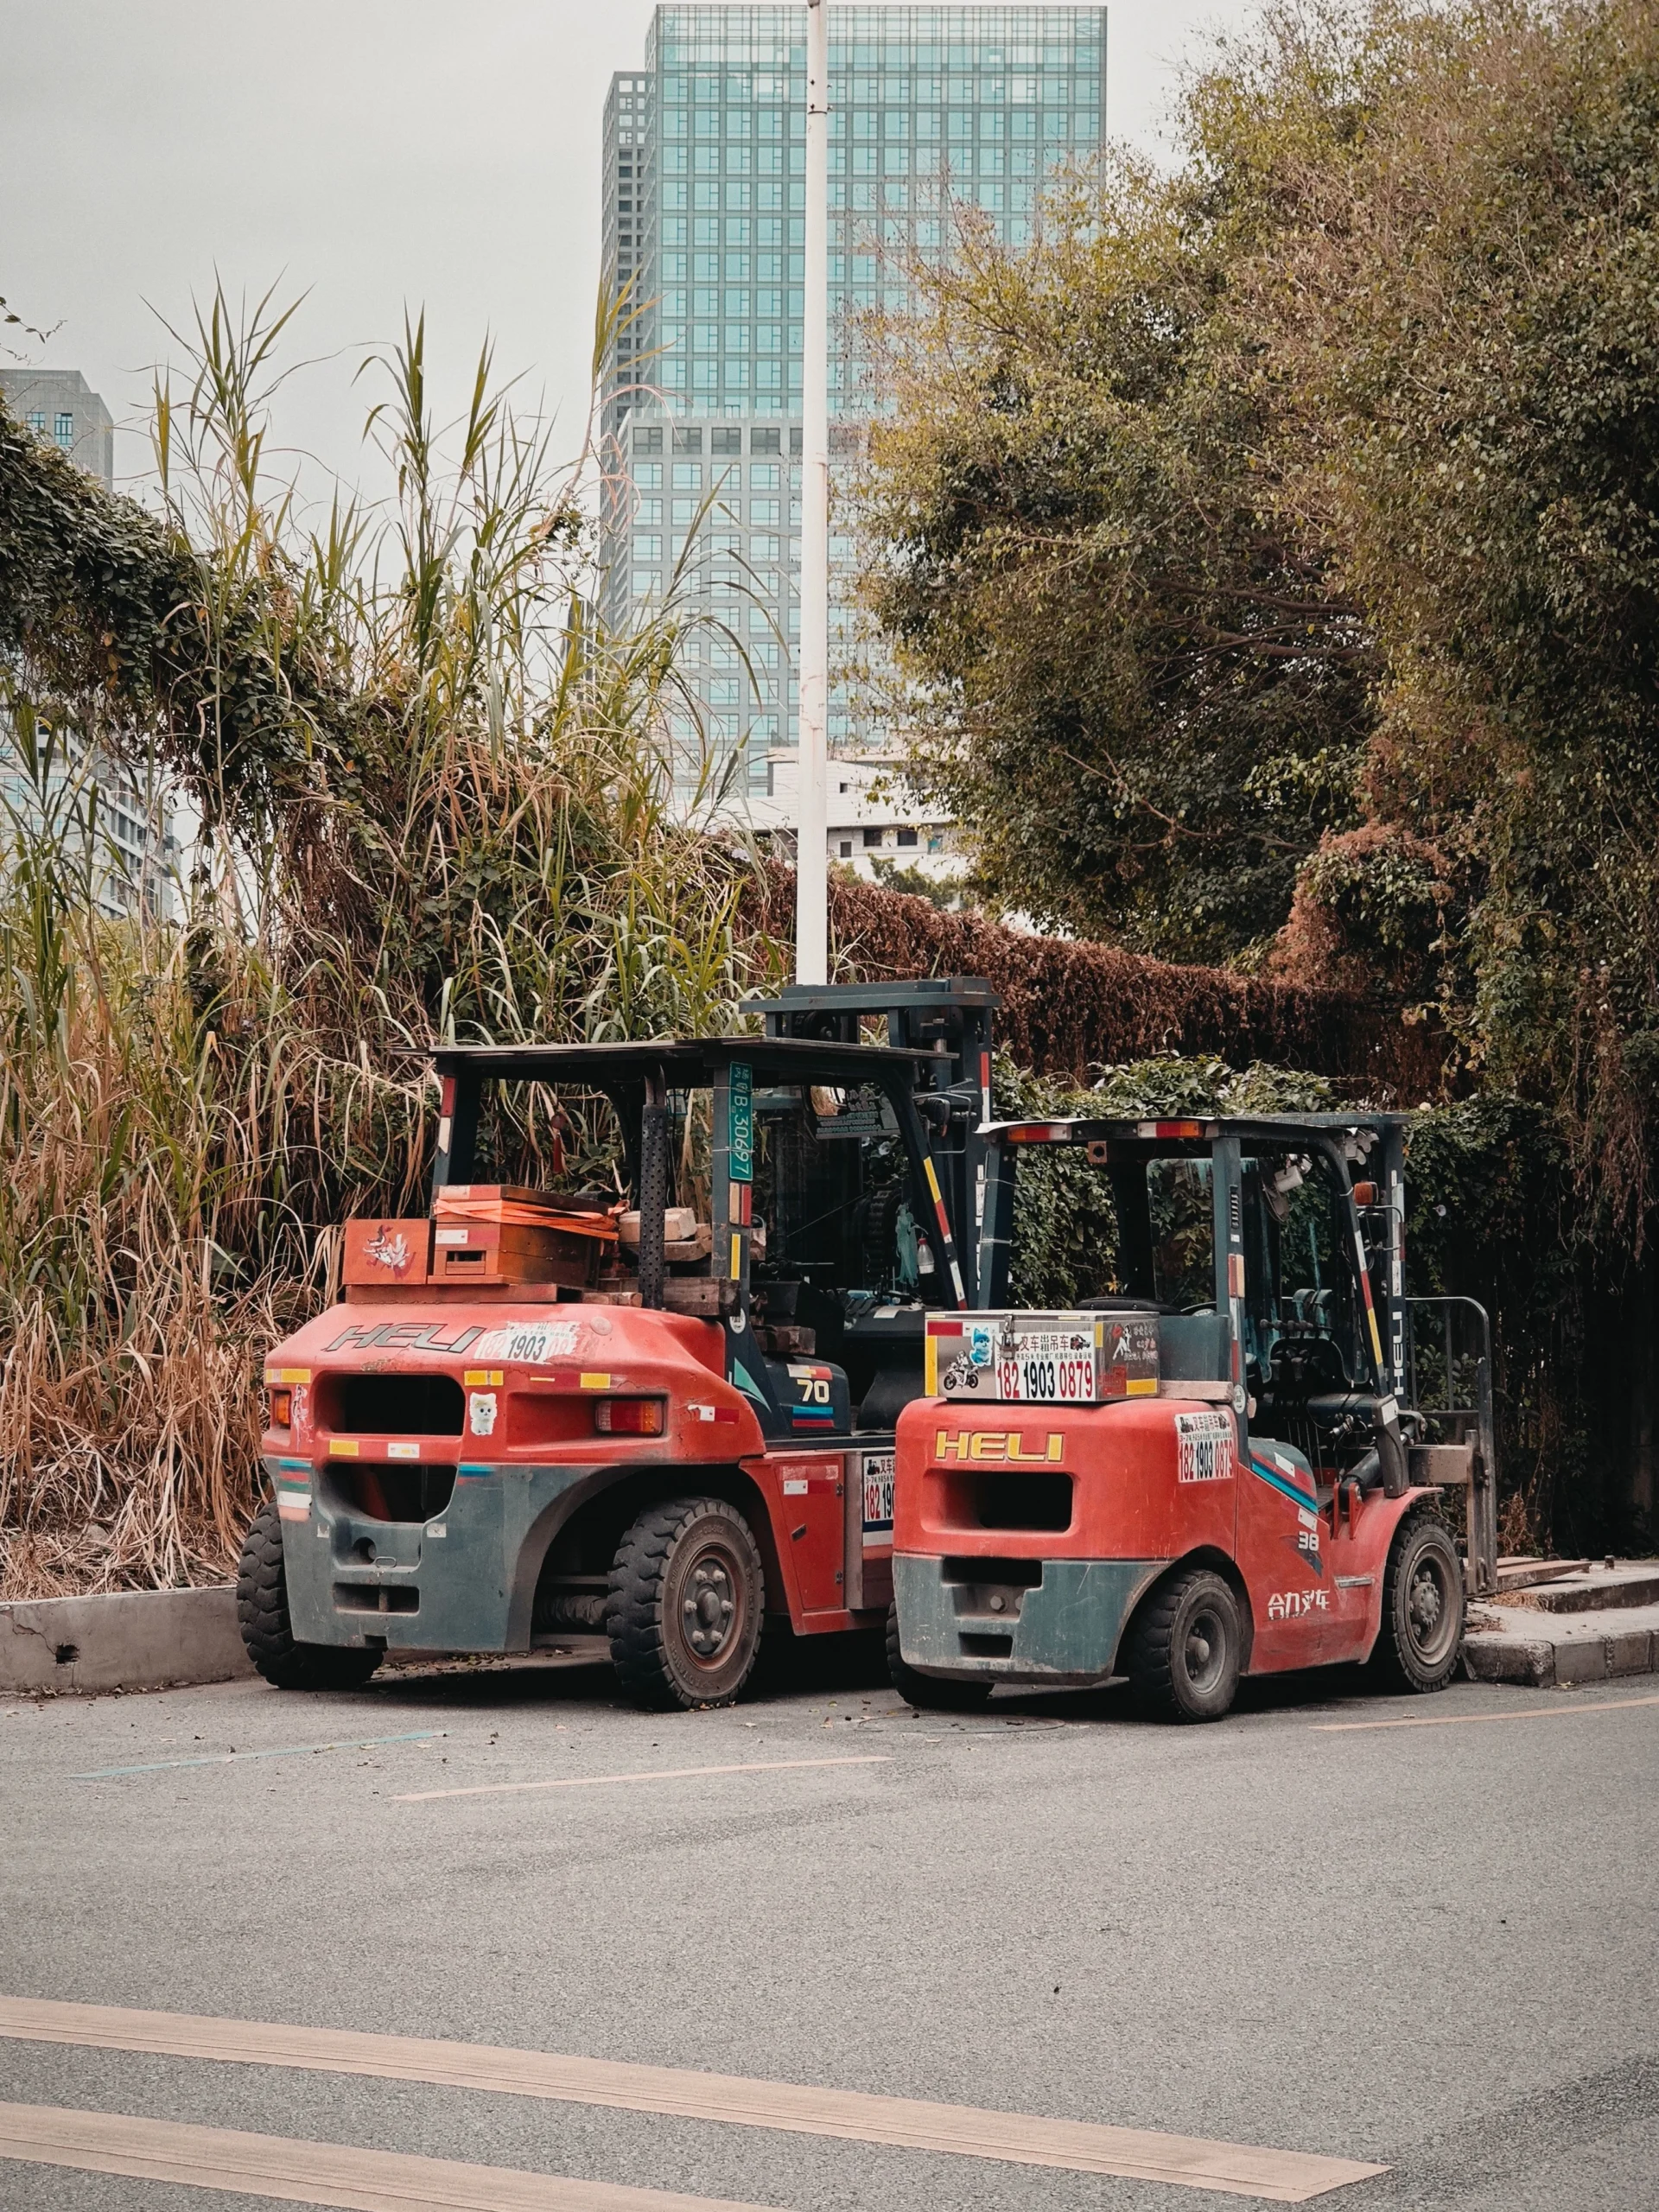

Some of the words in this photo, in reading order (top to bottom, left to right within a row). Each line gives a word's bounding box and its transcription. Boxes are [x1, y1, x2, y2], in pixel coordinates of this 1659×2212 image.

[321, 1322, 486, 1354] HELI
[507, 1334, 547, 1362] 1903
[1392, 1311, 1404, 1395] HELI
[797, 1378, 830, 1404] 70
[997, 1361, 1020, 1398] 182
[1023, 1361, 1056, 1399] 1903
[1059, 1360, 1093, 1398] 0879
[936, 1429, 1066, 1463] HELI
[1179, 1442, 1194, 1481] 182
[1196, 1440, 1213, 1480] 1903
[1215, 1439, 1234, 1478] 0879
[866, 1484, 880, 1521] 182
[1298, 1530, 1319, 1552] 38
